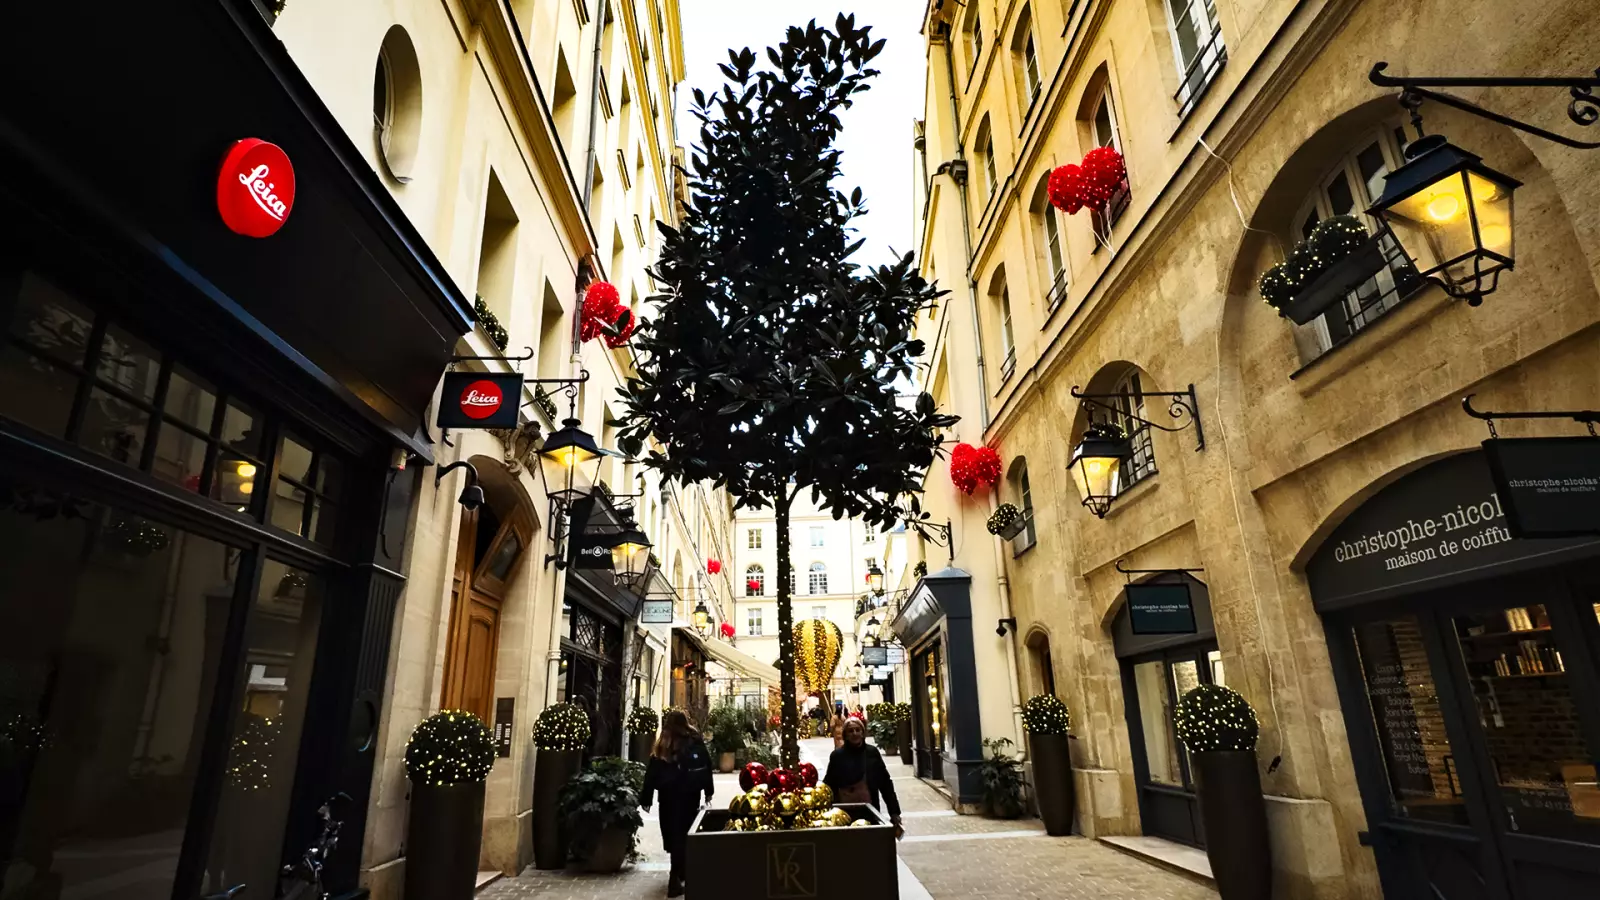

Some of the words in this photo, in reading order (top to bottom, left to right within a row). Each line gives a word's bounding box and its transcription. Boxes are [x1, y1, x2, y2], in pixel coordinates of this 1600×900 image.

[239, 164, 287, 221] Leica
[461, 389, 500, 407] Leica
[1335, 493, 1505, 562] christophe-nicol
[1385, 547, 1437, 570] maison
[1439, 540, 1459, 557] de
[1462, 526, 1512, 551] coiffu
